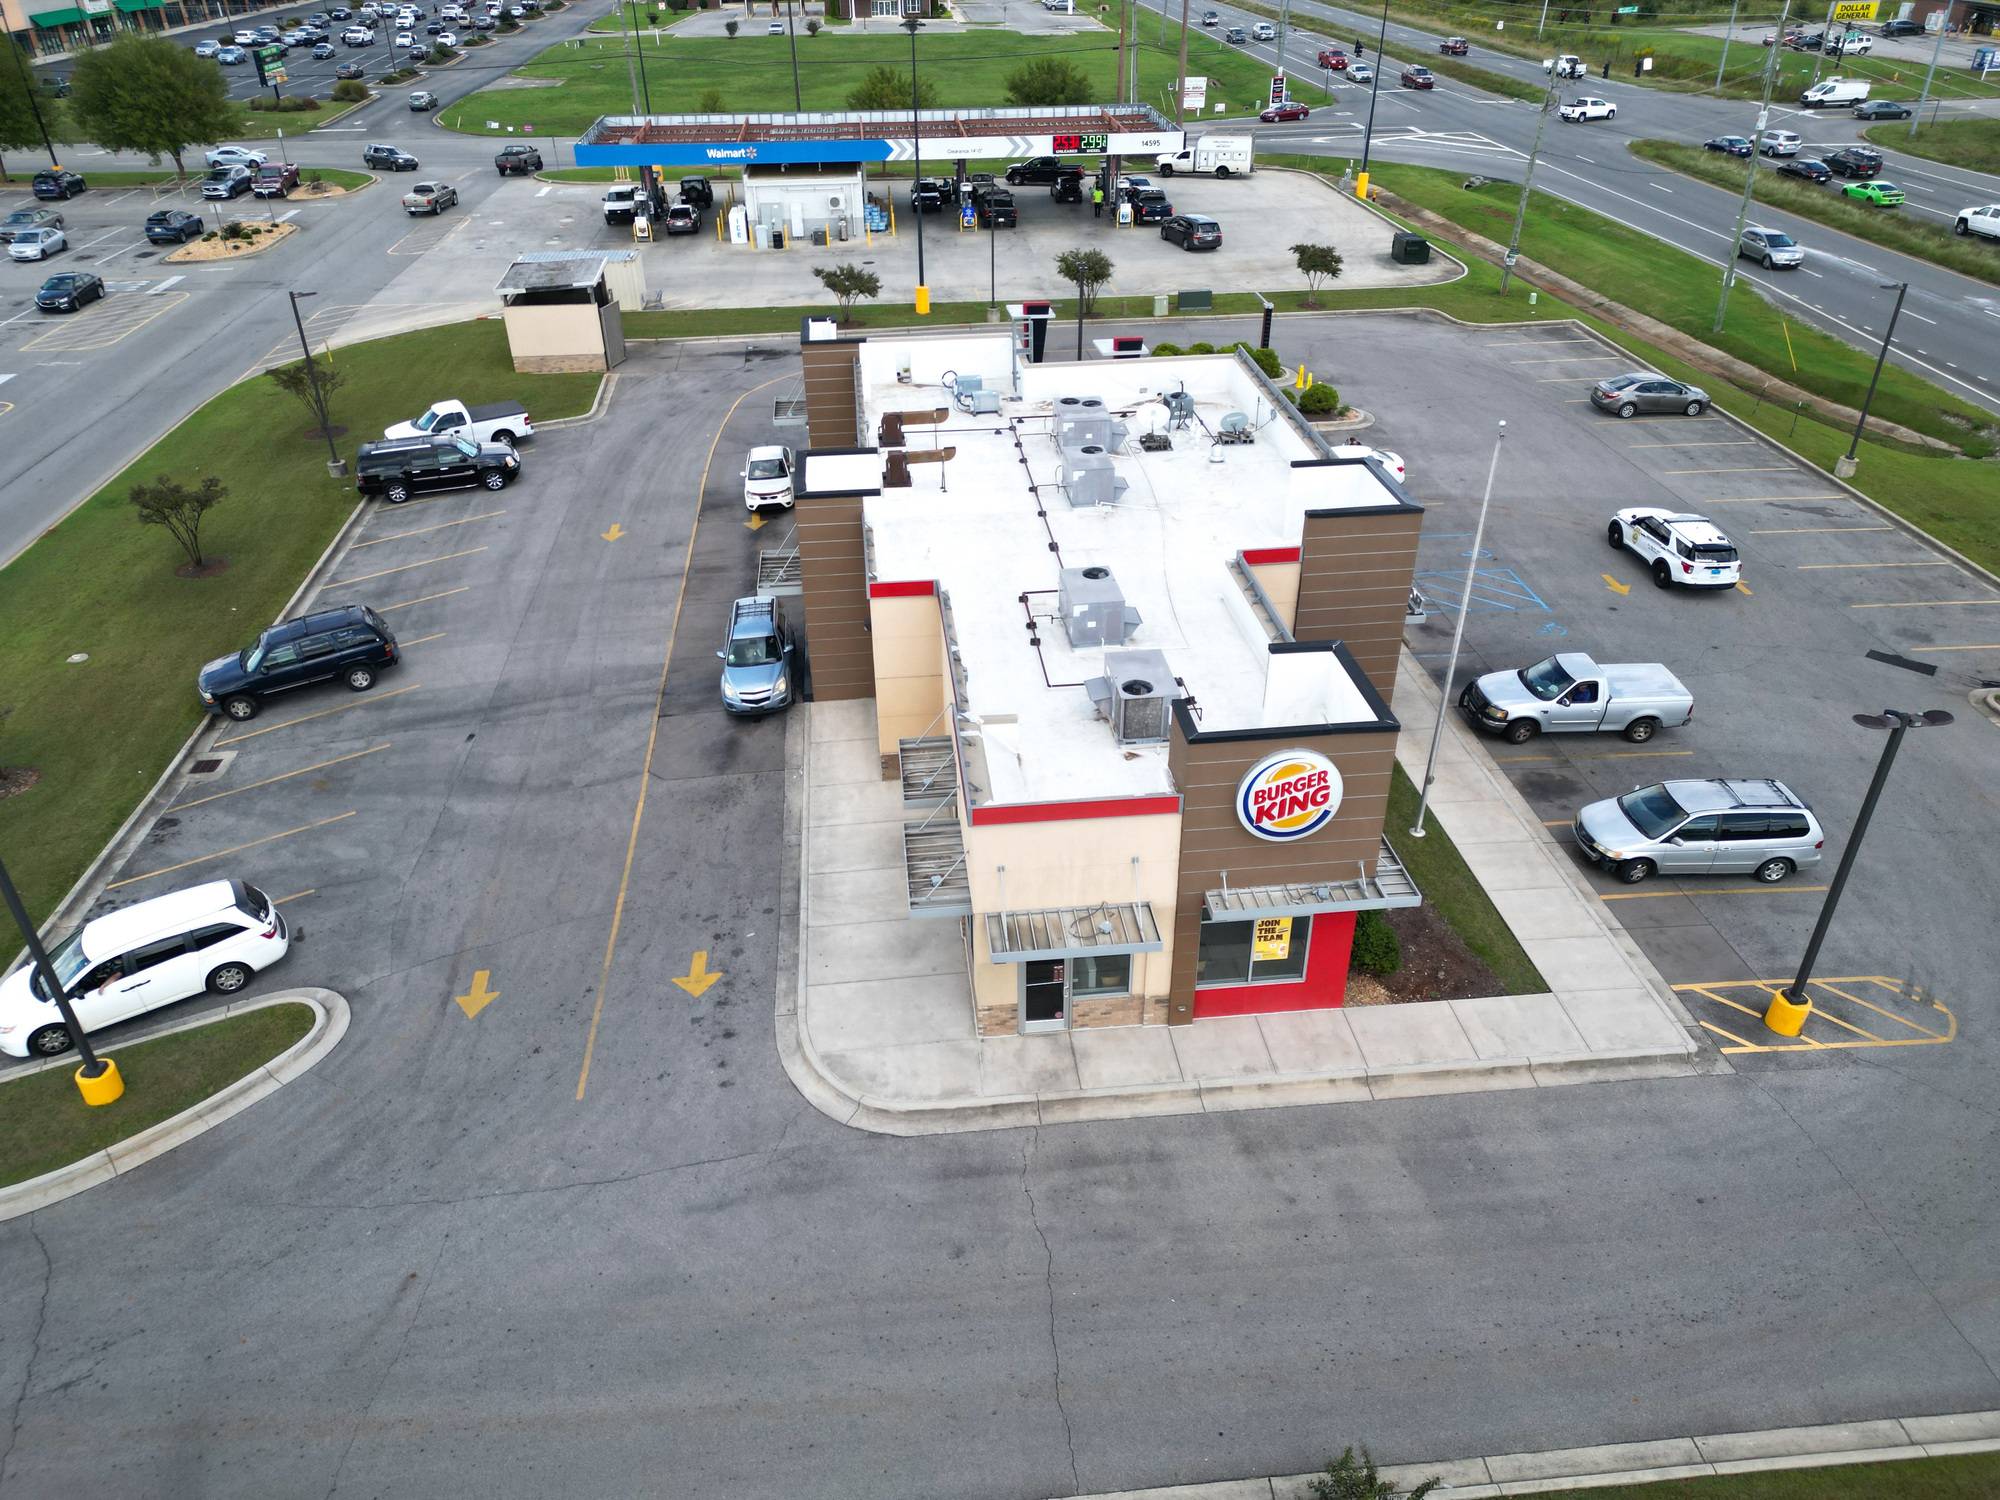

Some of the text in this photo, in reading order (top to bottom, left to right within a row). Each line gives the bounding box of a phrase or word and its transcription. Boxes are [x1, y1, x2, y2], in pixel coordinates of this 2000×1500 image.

[1840, 4, 1871, 12] DOLLAR
[1142, 139, 1161, 147] 14595
[706, 148, 746, 158] Walmart
[1253, 770, 1329, 805] BURGER
[1255, 785, 1331, 824] KING
[1258, 919, 1281, 927] JOIN
[1257, 934, 1283, 942] TEAM
